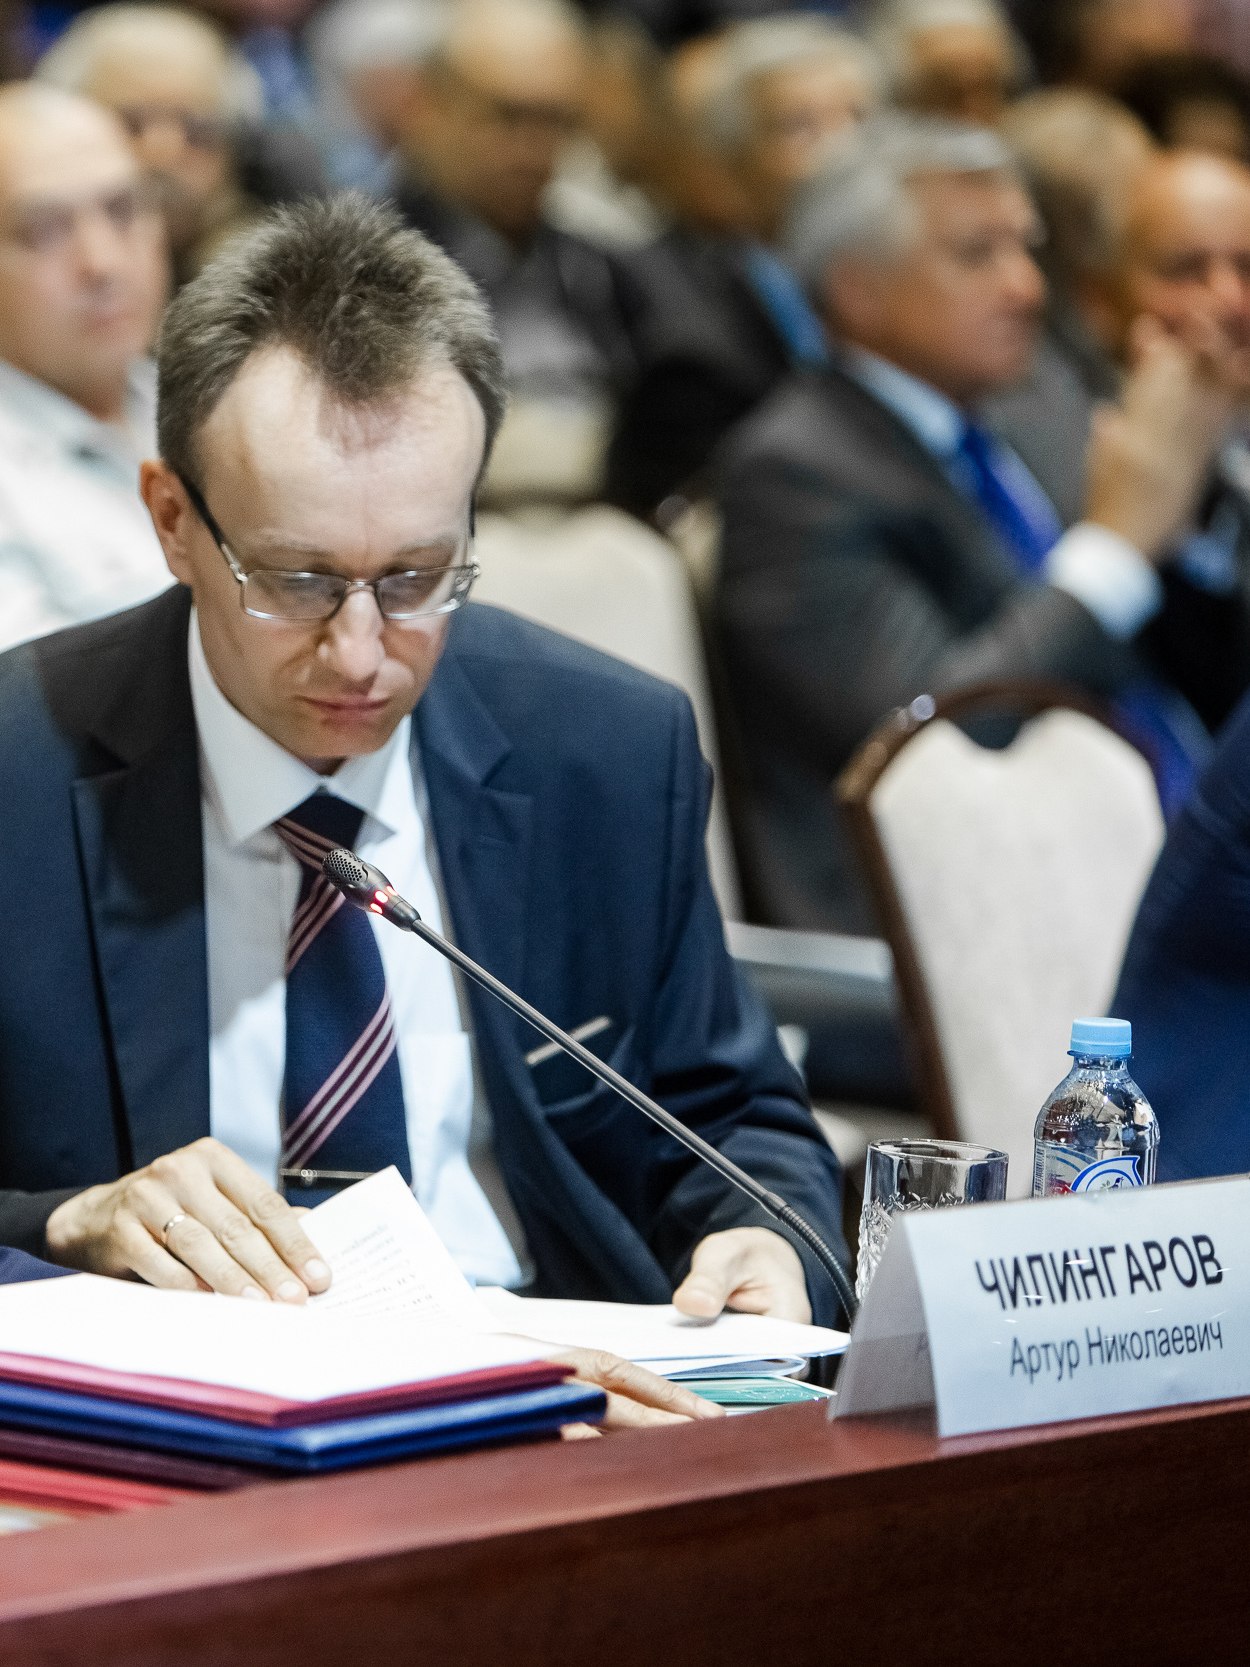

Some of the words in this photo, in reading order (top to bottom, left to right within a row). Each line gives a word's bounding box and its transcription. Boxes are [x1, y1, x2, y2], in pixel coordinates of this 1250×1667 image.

[975, 1234, 1223, 1310] ЧИЛИНГАРОВ
[1010, 1336, 1081, 1384] Артур
[1085, 1321, 1223, 1366] Николаевич
